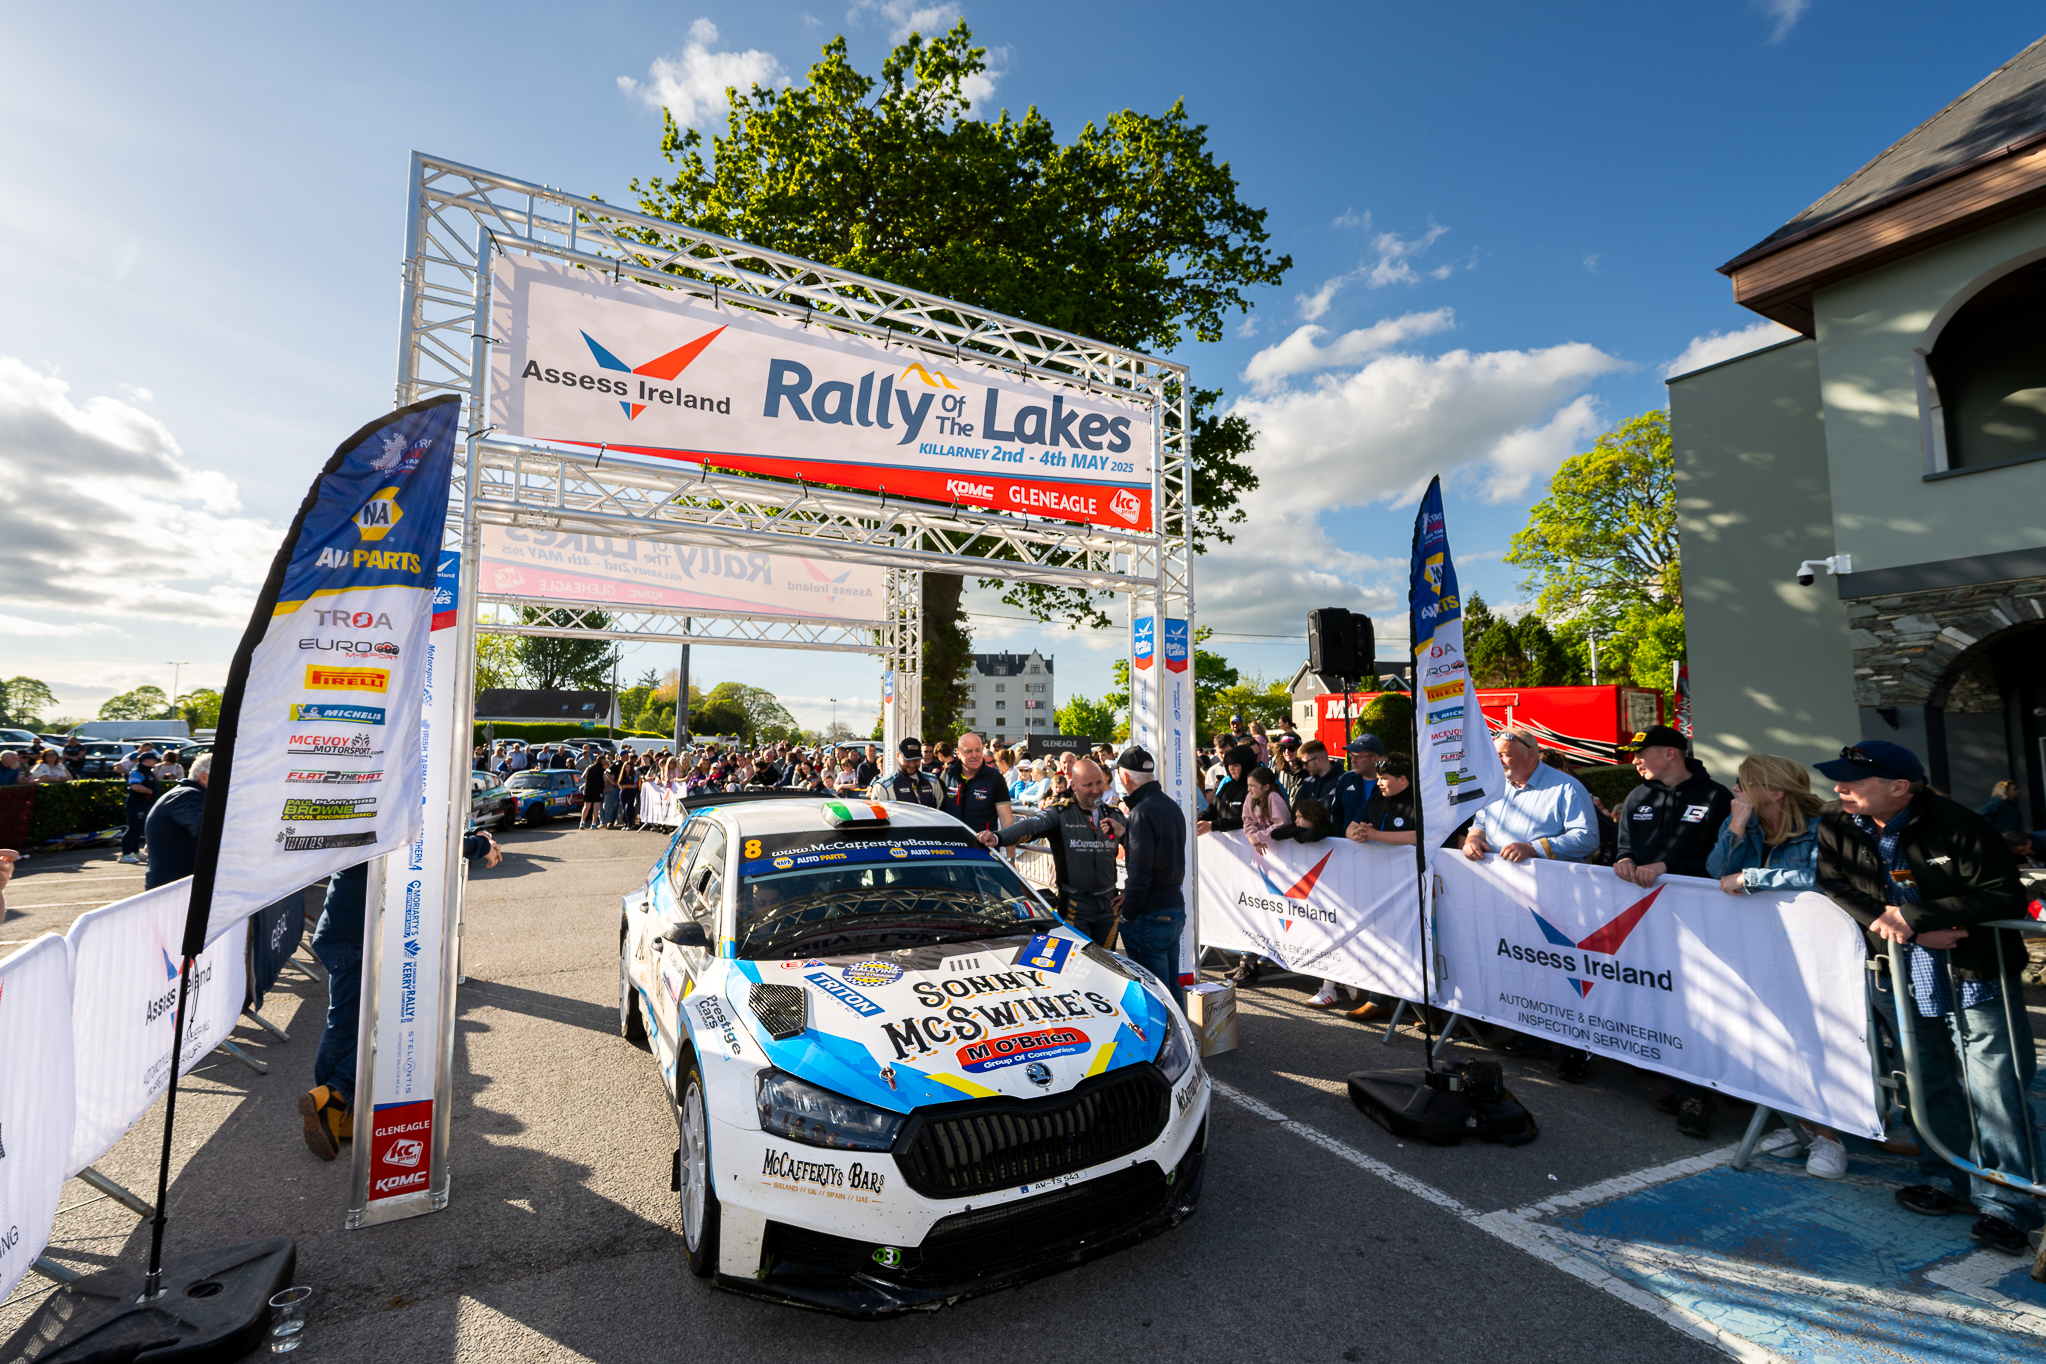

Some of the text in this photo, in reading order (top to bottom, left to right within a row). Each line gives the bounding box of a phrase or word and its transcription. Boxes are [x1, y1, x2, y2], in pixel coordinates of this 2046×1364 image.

[521, 360, 731, 415] Assess Ireland
[763, 358, 936, 445] Rally
[941, 393, 966, 418] Of
[935, 415, 974, 437] The
[982, 387, 1132, 453] Lakes
[919, 443, 989, 460] KILLARNEY
[991, 446, 1025, 463] 2nd
[1039, 450, 1067, 467] 4th
[1070, 453, 1109, 471] MAY
[1110, 461, 1134, 473] 2025
[1008, 485, 1097, 515] GLENEAGLE
[353, 551, 421, 574] PARTS
[314, 609, 393, 631] TROA
[299, 638, 372, 653] EURO
[345, 652, 399, 661] M-SPORT
[312, 670, 385, 688] PIRELLI
[289, 735, 350, 747] MCEVOY
[284, 805, 354, 815] BROWNE
[744, 839, 762, 859] 8
[771, 838, 968, 857] www.McCaffertysBars.com
[797, 855, 820, 864] AUTO
[819, 853, 847, 861] PARTS
[411, 889, 421, 936] MORIARTY'S
[1238, 891, 1337, 924] Assess Ireland
[402, 961, 413, 990] KERRY
[849, 966, 899, 975] RALLYING
[1497, 938, 1674, 992] Assess Ireland
[802, 979, 860, 1019] SHOWERS
[813, 974, 877, 1013] TRITON
[913, 970, 1046, 1008] SONNY
[405, 990, 416, 1017] RALLY
[698, 1000, 718, 1029] Cars
[706, 994, 741, 1055] Prestige
[1499, 992, 1684, 1051] AUTOMOTIVE & ENGINEERING
[965, 1031, 1077, 1061] M O'Brien
[1518, 1011, 1662, 1061] INSPECTION SERVICES
[405, 1030, 414, 1093] STELLANTIS
[983, 1046, 1076, 1068] Group Of Companies
[375, 1120, 430, 1137] GLENEAGLE
[397, 1154, 417, 1163] print
[773, 1182, 799, 1192] IRELAND
[808, 1188, 817, 1196] UK
[826, 1191, 846, 1200] SPAIN
